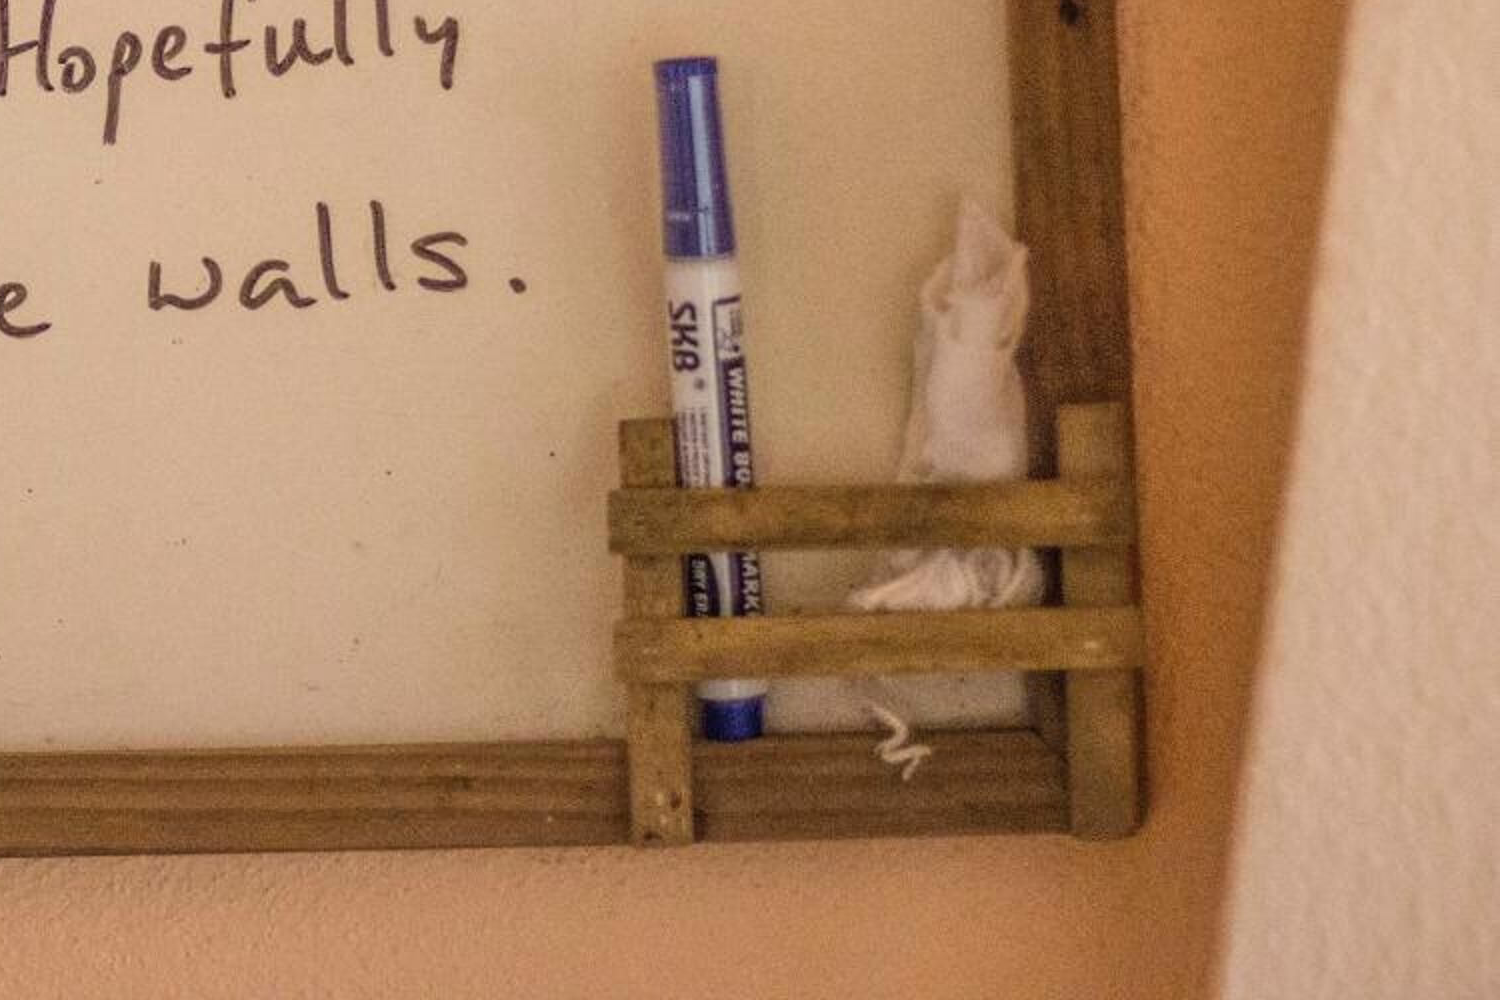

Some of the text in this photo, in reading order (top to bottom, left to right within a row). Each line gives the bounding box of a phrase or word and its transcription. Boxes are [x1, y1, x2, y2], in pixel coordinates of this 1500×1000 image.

[147, 199, 527, 312] walls.
[668, 300, 700, 373] SKB
[728, 367, 748, 443] WHITE
